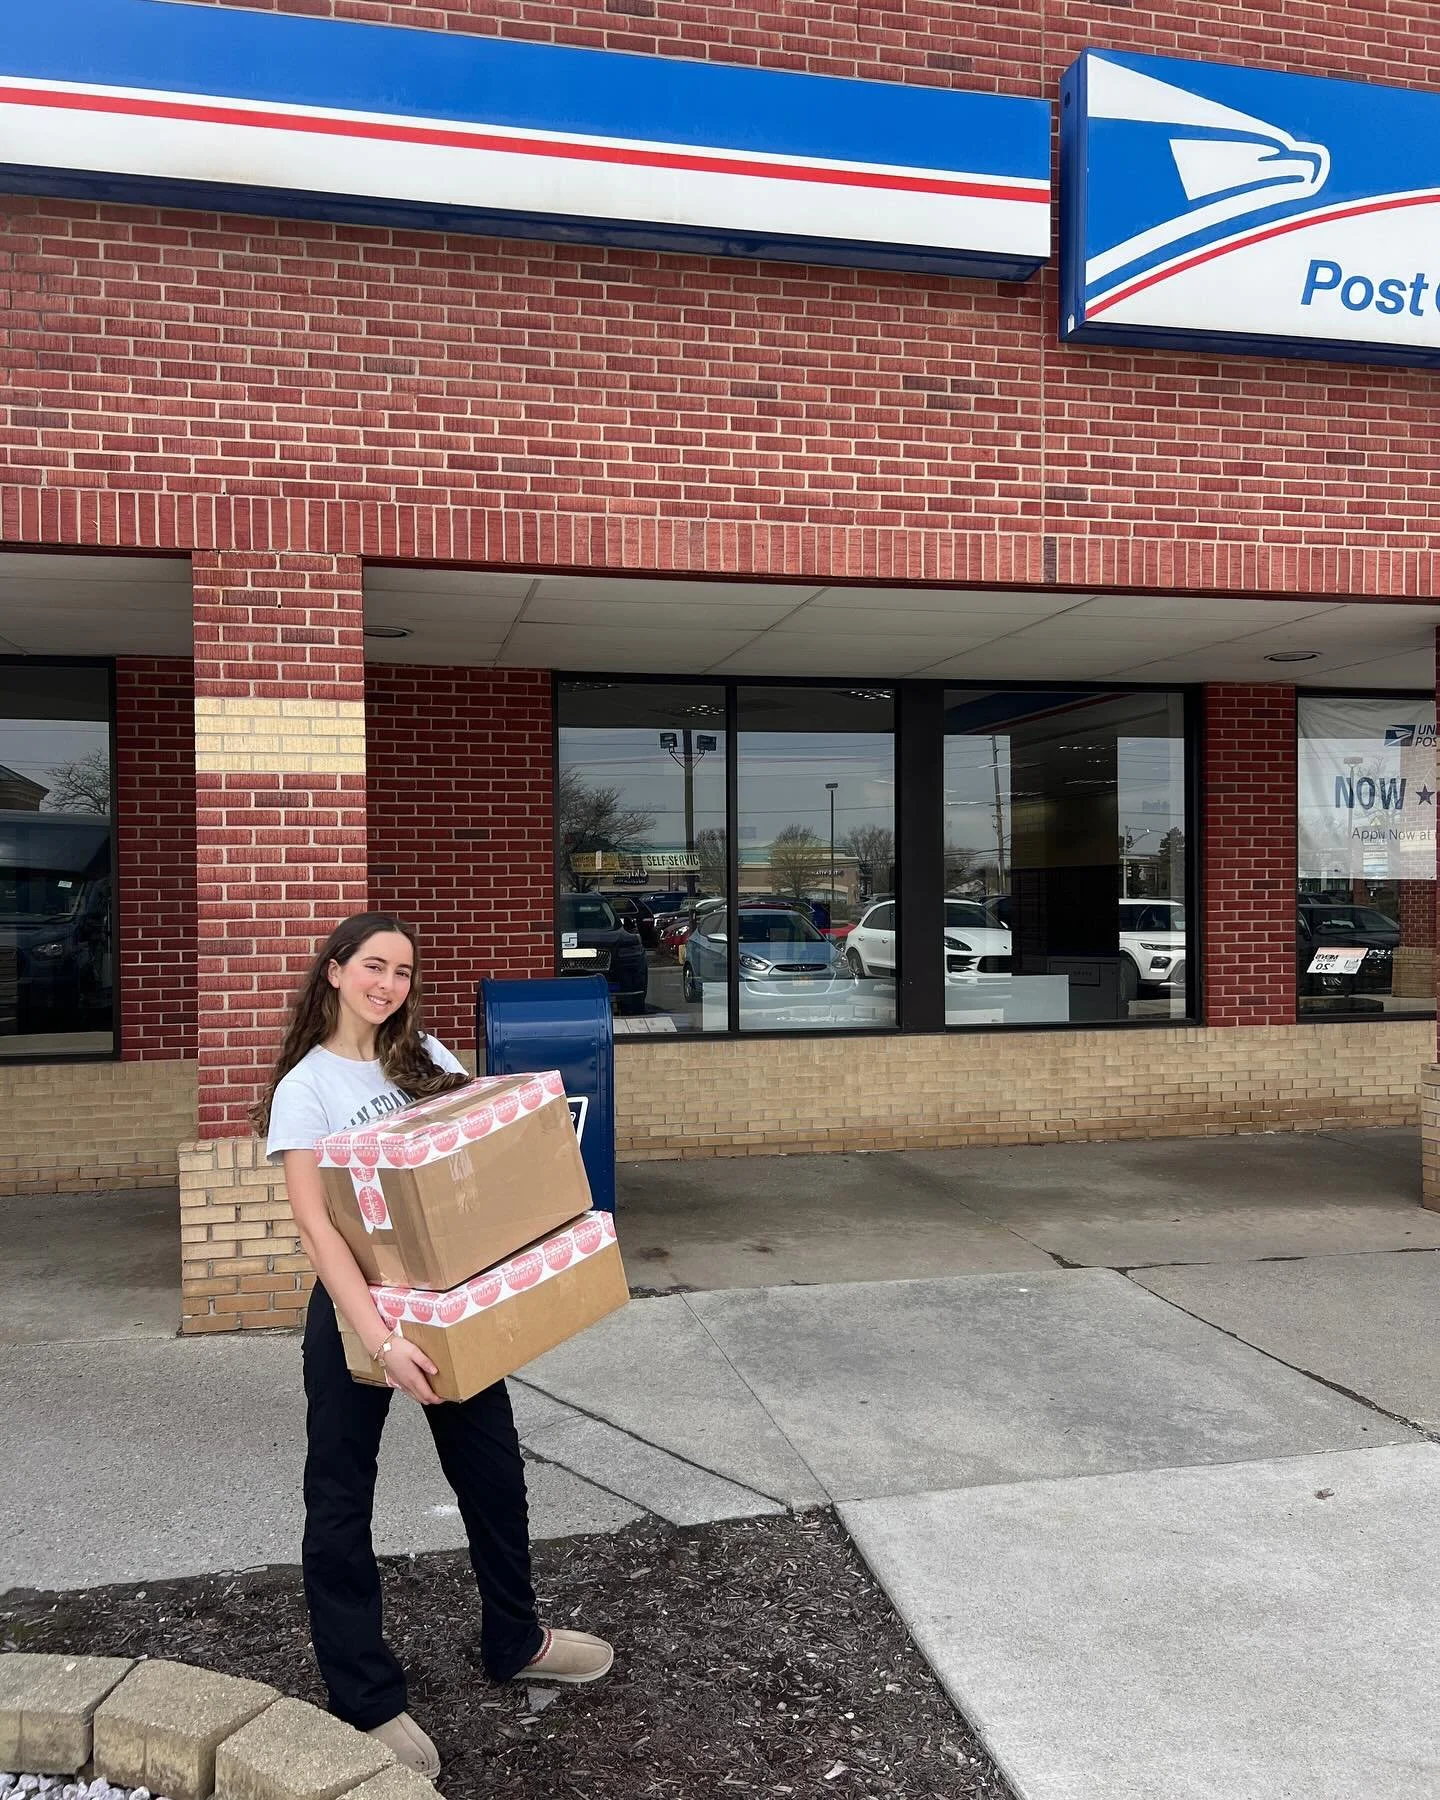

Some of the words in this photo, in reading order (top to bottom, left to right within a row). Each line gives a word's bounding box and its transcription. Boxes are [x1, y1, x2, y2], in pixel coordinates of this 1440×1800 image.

[1301, 259, 1429, 316] Post
[1335, 775, 1407, 810] NOW
[1389, 828, 1415, 841] Now
[1419, 830, 1431, 841] at
